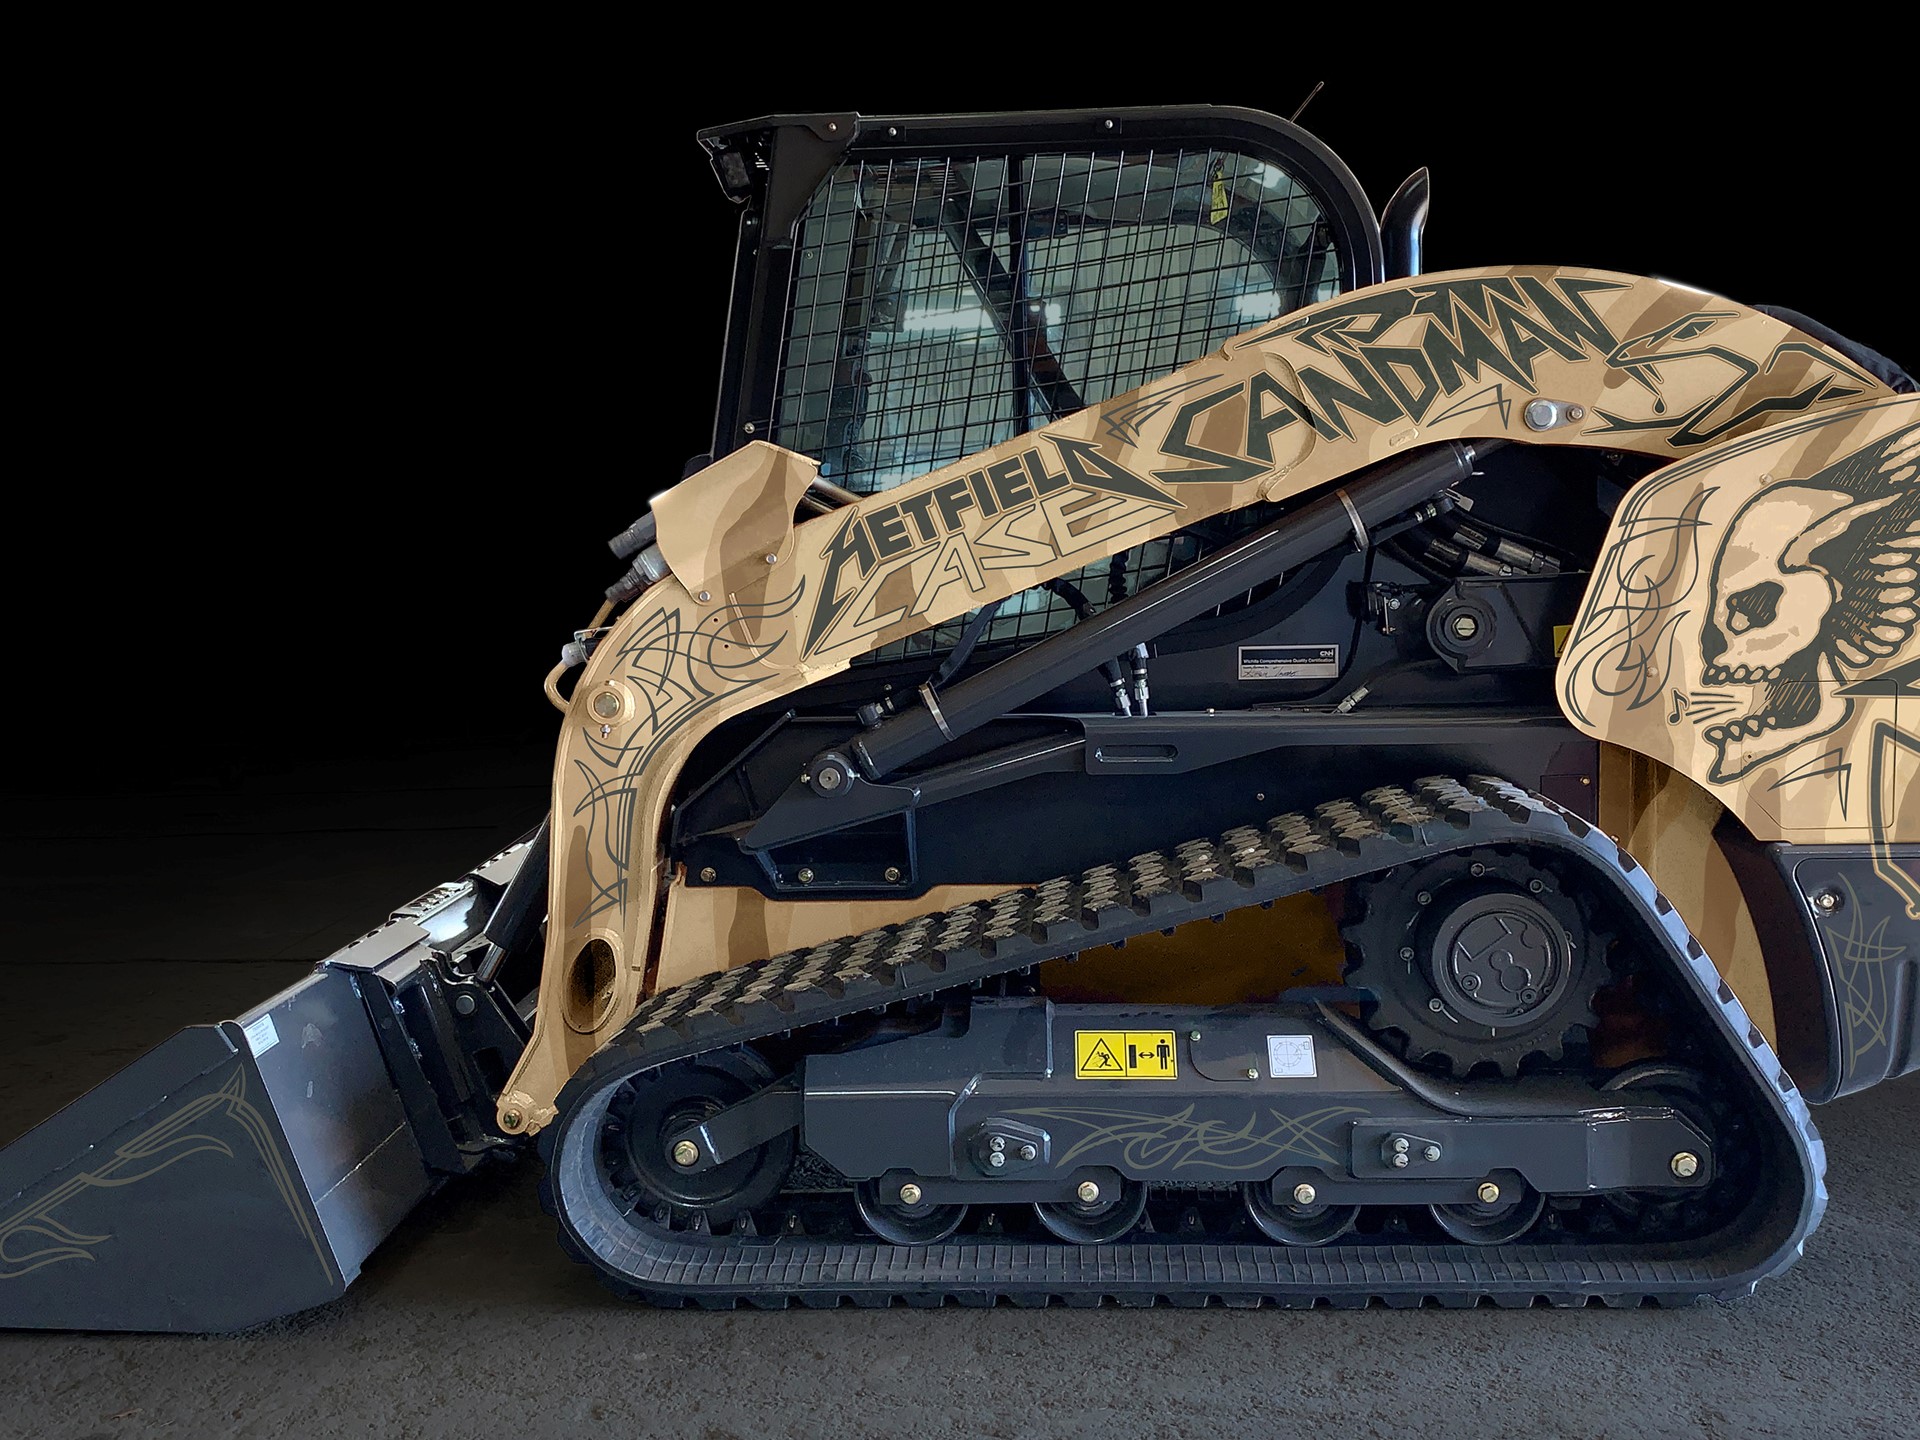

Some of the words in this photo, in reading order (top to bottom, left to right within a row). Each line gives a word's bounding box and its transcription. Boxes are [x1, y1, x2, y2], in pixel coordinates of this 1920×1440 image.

[1150, 276, 1633, 484] SANDMAN
[801, 433, 1187, 660] HETFIELD
[815, 488, 1176, 655] CASE
